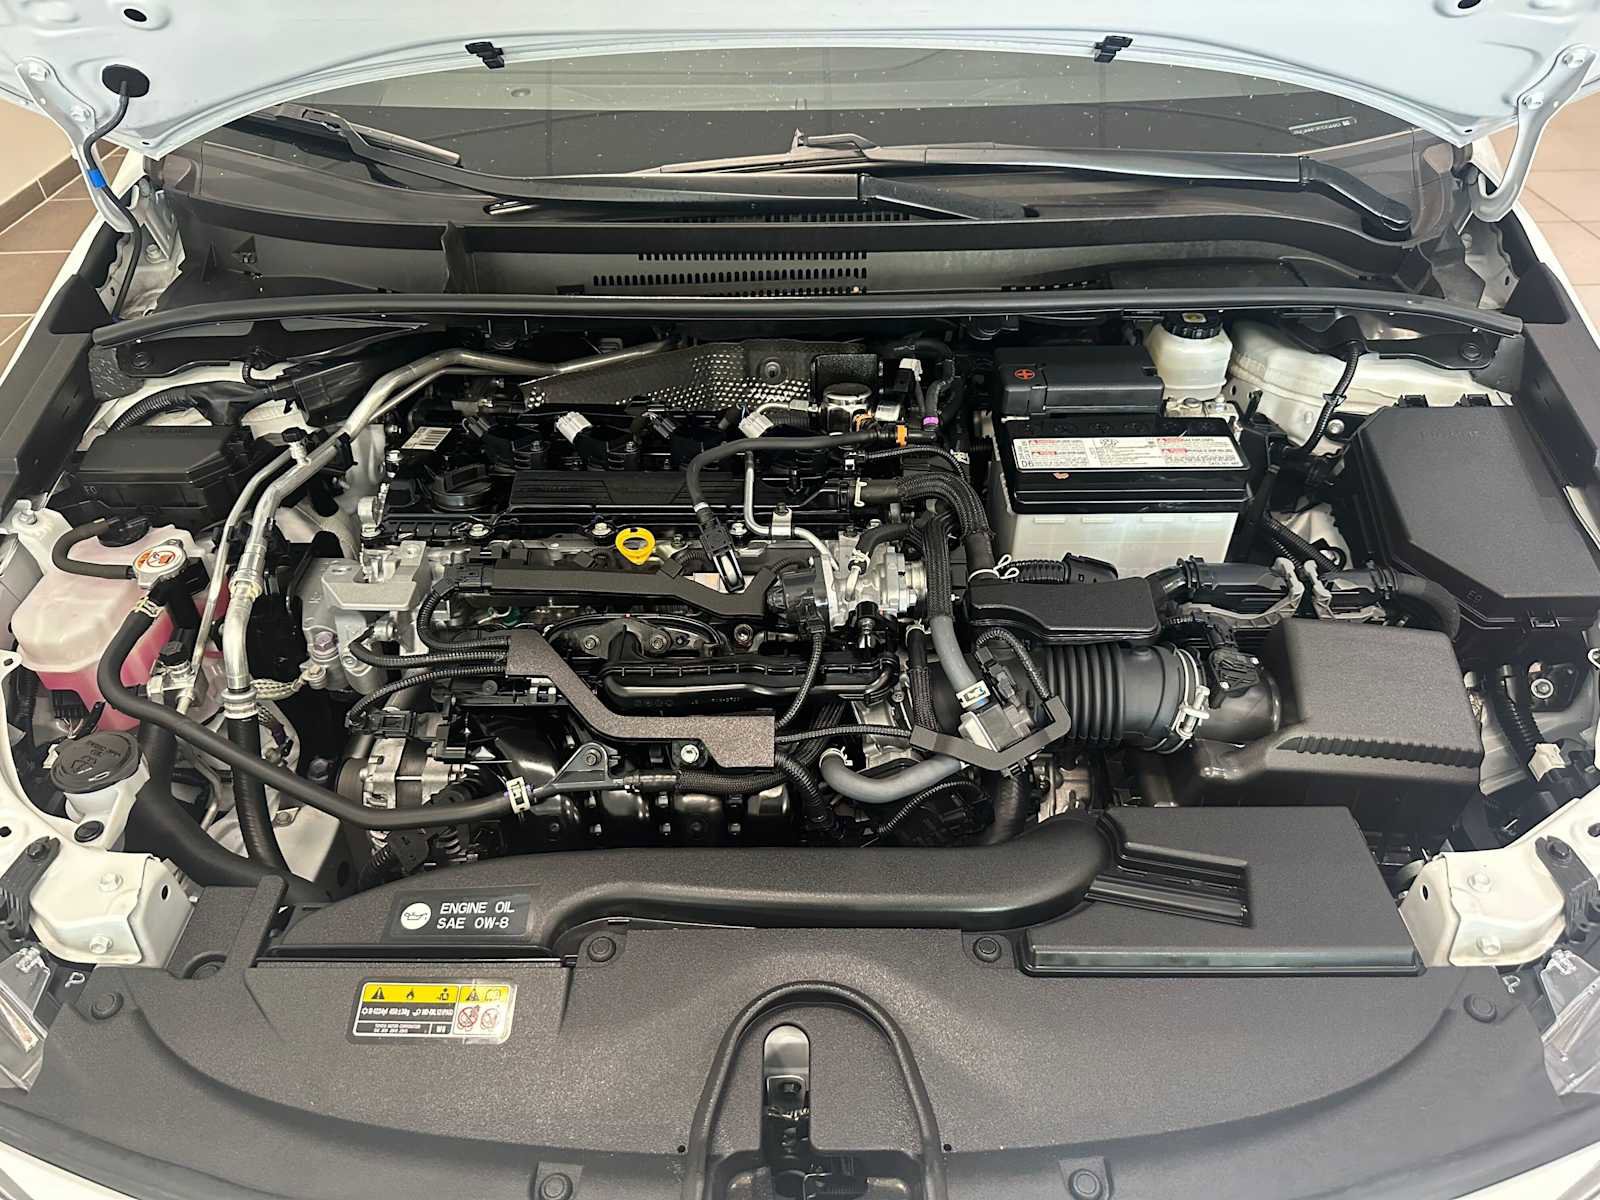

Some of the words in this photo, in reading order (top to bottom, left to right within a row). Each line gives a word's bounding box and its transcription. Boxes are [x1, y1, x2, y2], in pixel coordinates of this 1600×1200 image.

[440, 902, 488, 914] ENGINE
[494, 901, 515, 913] OIL
[436, 917, 466, 929] SAE
